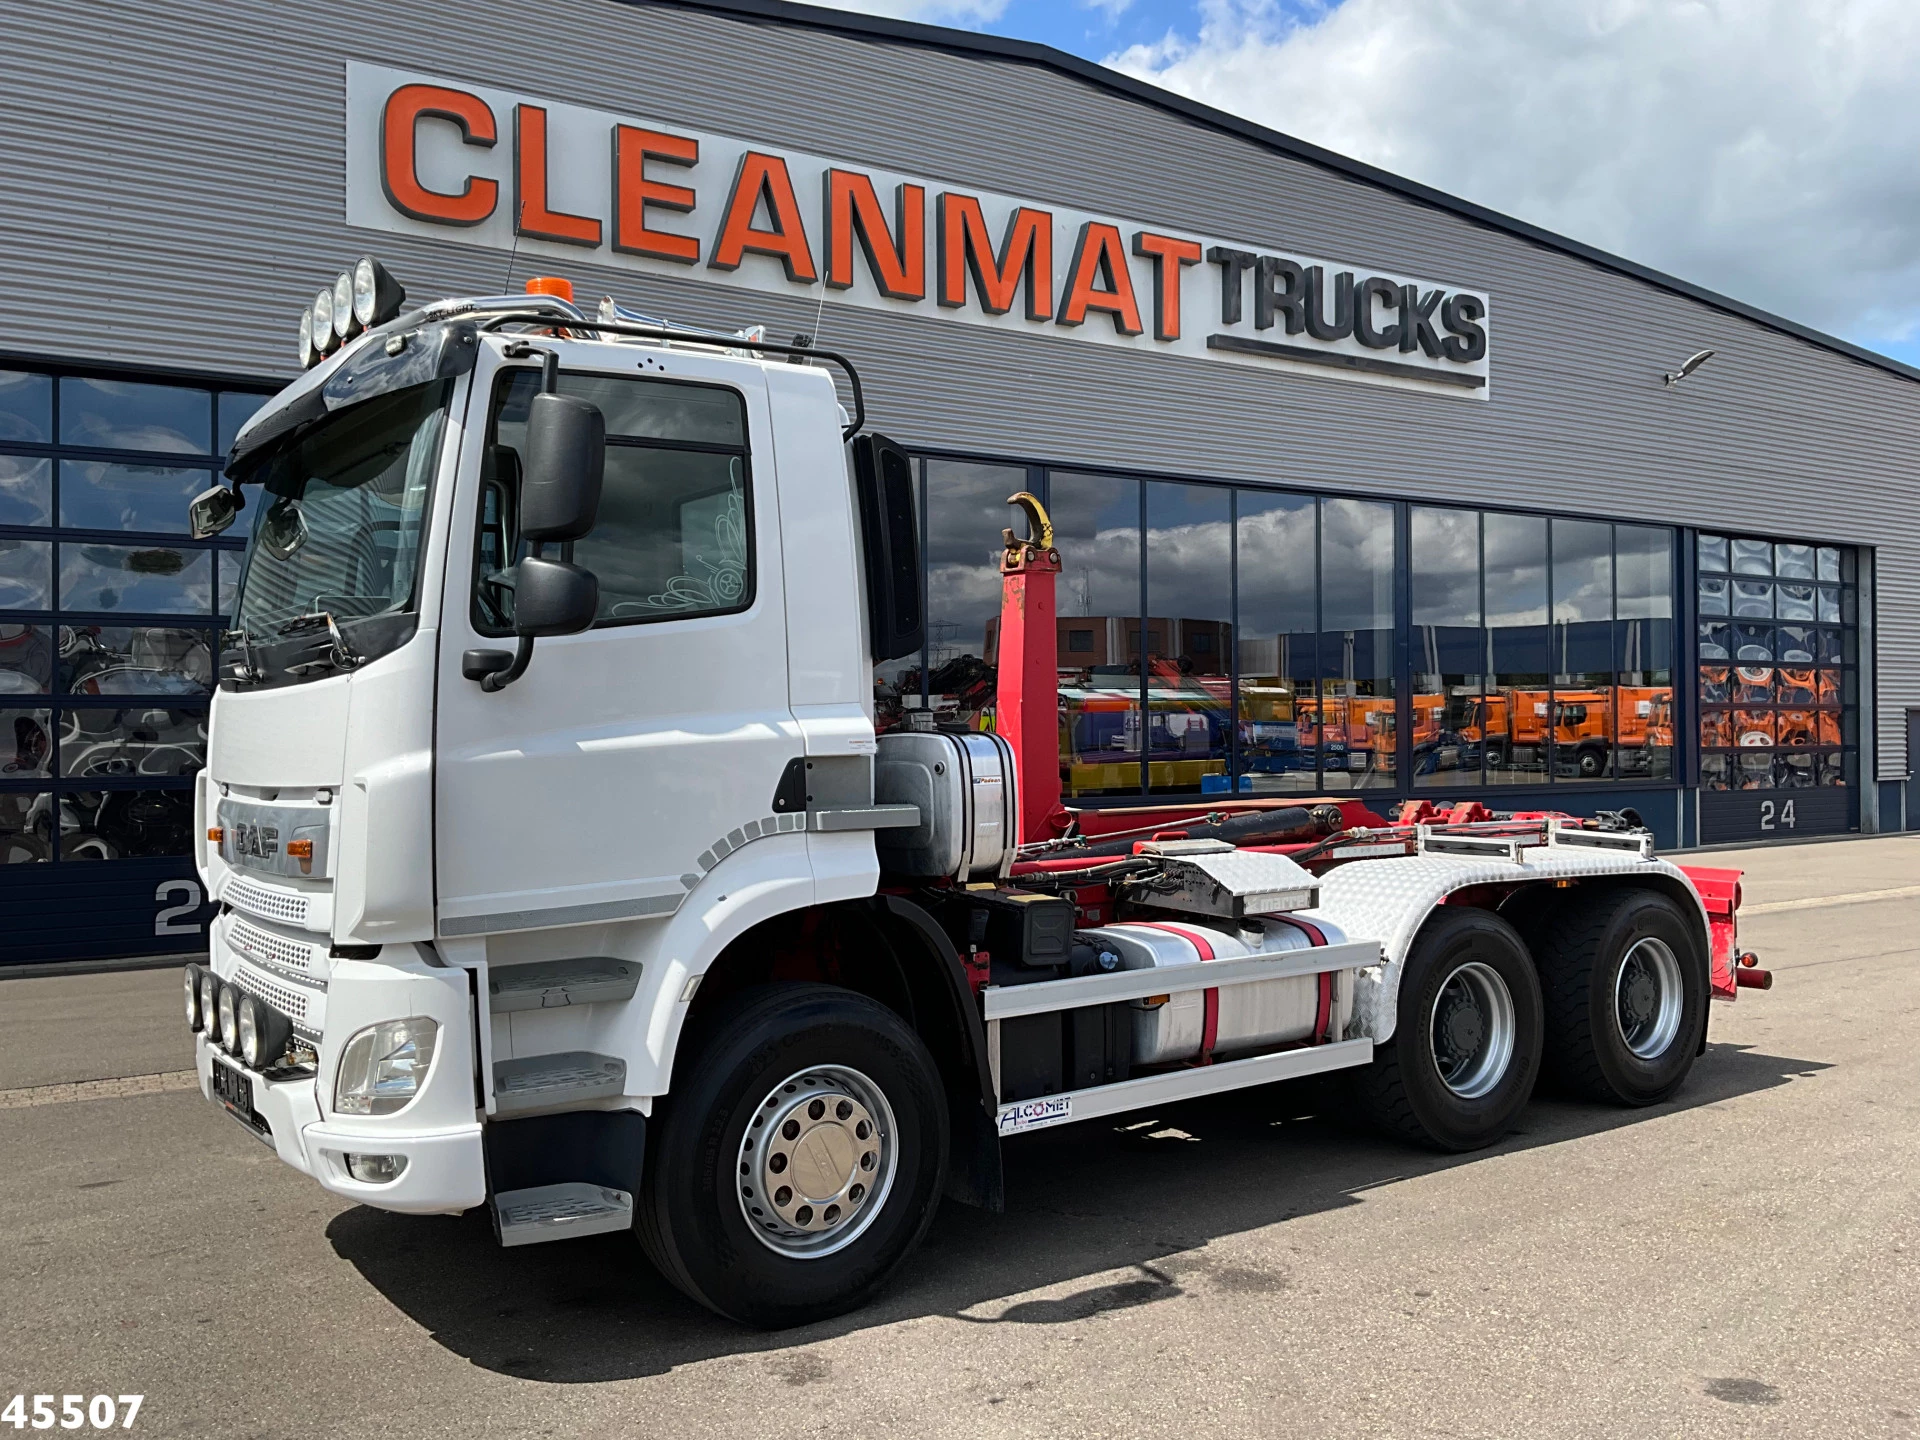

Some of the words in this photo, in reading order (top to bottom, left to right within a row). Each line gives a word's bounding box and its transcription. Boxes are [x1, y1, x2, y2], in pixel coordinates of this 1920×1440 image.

[380, 83, 1201, 341] CLEANMAT
[1207, 246, 1486, 363] TRUCKS
[446, 304, 474, 315] LIGHT
[1761, 800, 1796, 830] 24
[236, 822, 278, 859] DAF
[1000, 1097, 1070, 1129] ALCOMET
